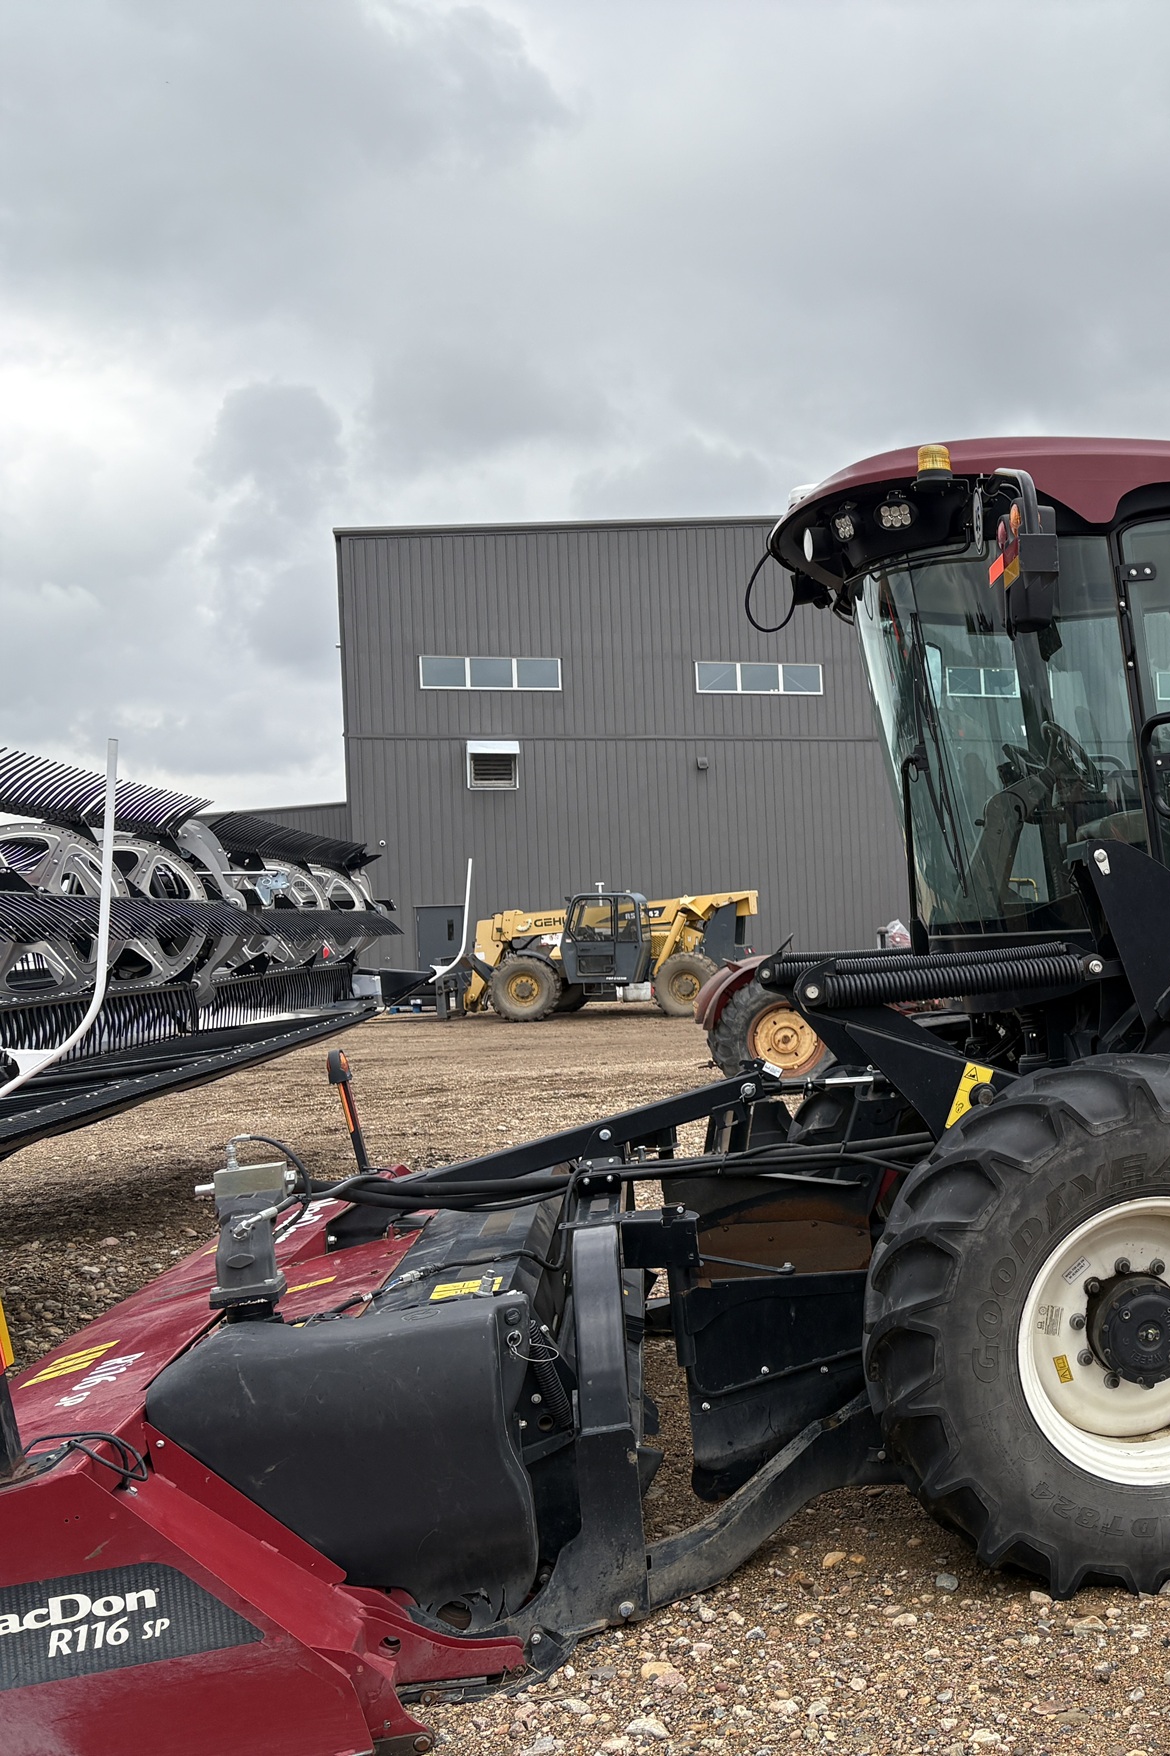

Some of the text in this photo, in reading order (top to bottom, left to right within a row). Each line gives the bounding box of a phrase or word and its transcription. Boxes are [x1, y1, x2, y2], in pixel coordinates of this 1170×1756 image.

[72, 1352, 145, 1391] R116
[1130, 1348, 1163, 1366] WHEEL
[1030, 1480, 1158, 1538] DT824
[0, 1588, 157, 1636] acDon
[48, 1617, 170, 1658] R116 SP
